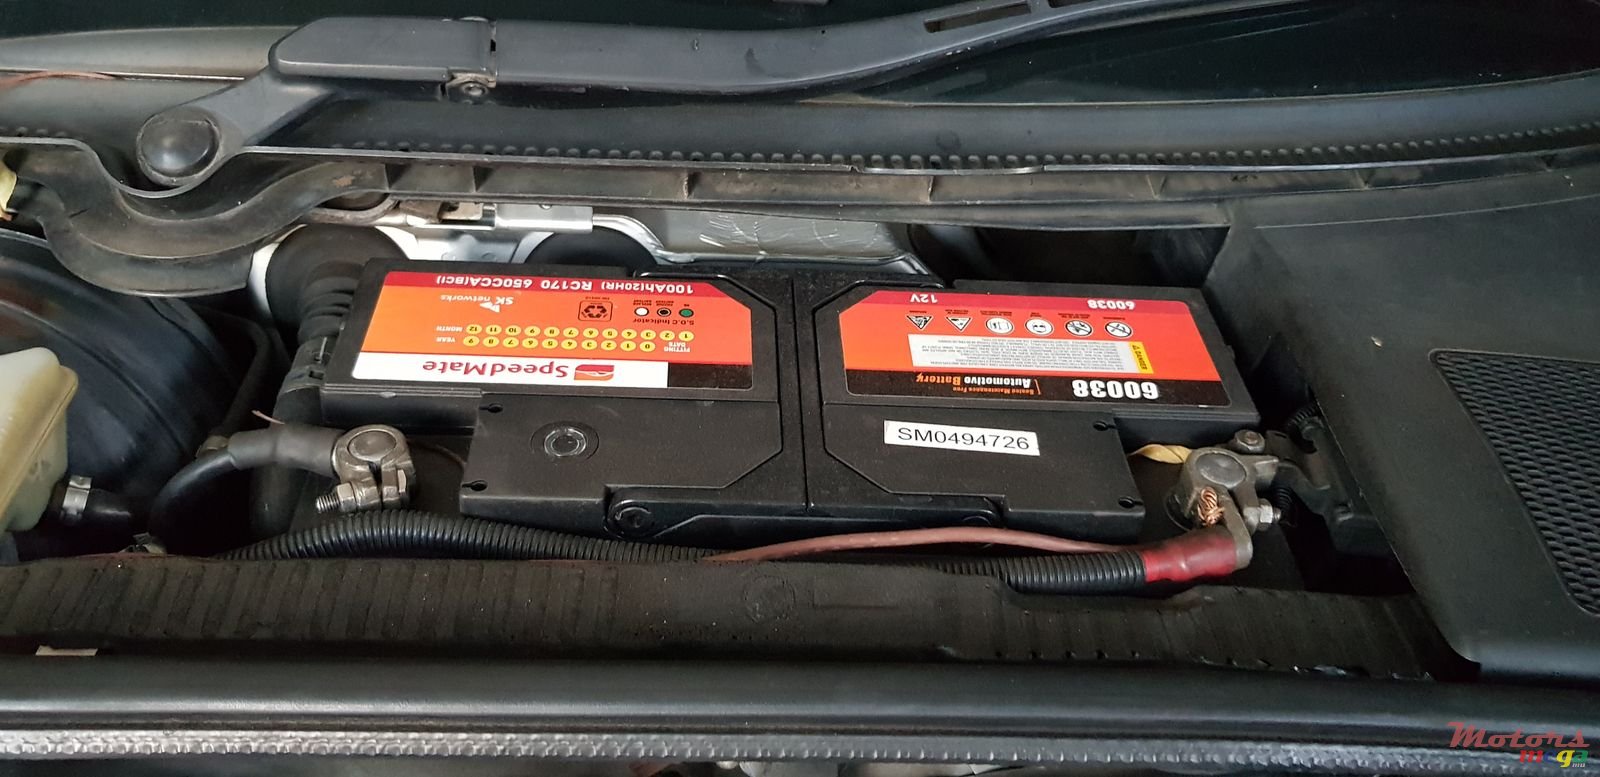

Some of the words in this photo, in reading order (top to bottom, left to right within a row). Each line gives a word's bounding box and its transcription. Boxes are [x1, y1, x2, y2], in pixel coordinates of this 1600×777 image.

[436, 276, 532, 288] 650CCA(BCI)
[540, 280, 592, 290] RC170
[601, 282, 693, 294] 100Ah(20HR)
[496, 296, 514, 305] SK
[910, 293, 938, 304] 12V
[1087, 299, 1136, 310] 60038
[1072, 380, 1159, 400] 60038
[898, 428, 1030, 450] SM0494726
